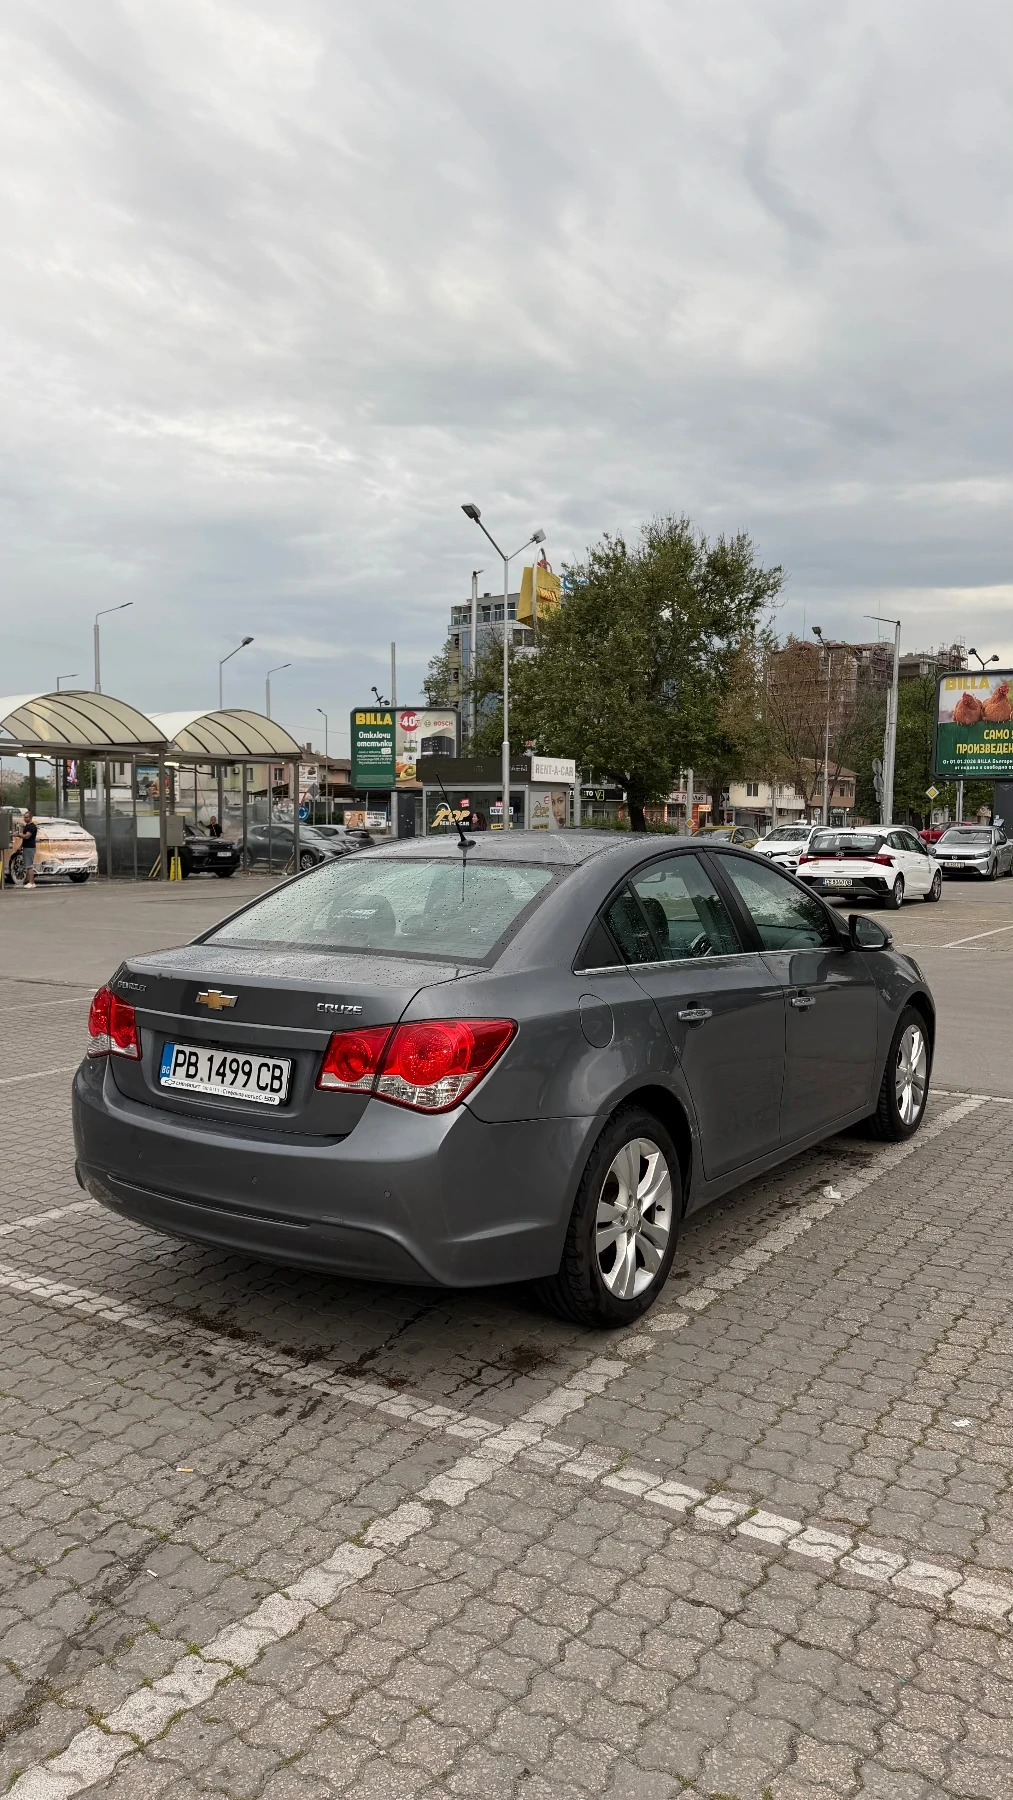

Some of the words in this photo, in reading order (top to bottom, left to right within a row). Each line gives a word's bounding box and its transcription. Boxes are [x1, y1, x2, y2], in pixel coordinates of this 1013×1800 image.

[945, 676, 990, 690] BILLA
[355, 712, 392, 725] BILLA
[983, 729, 1009, 740] САМО
[535, 764, 574, 776] RENT-A-CAR
[431, 808, 471, 828] TOP
[316, 1002, 363, 1015] CRUZE
[161, 1065, 170, 1075] BG
[172, 1048, 199, 1079] PB
[207, 1054, 253, 1088] 1499
[256, 1062, 284, 1094] CB
